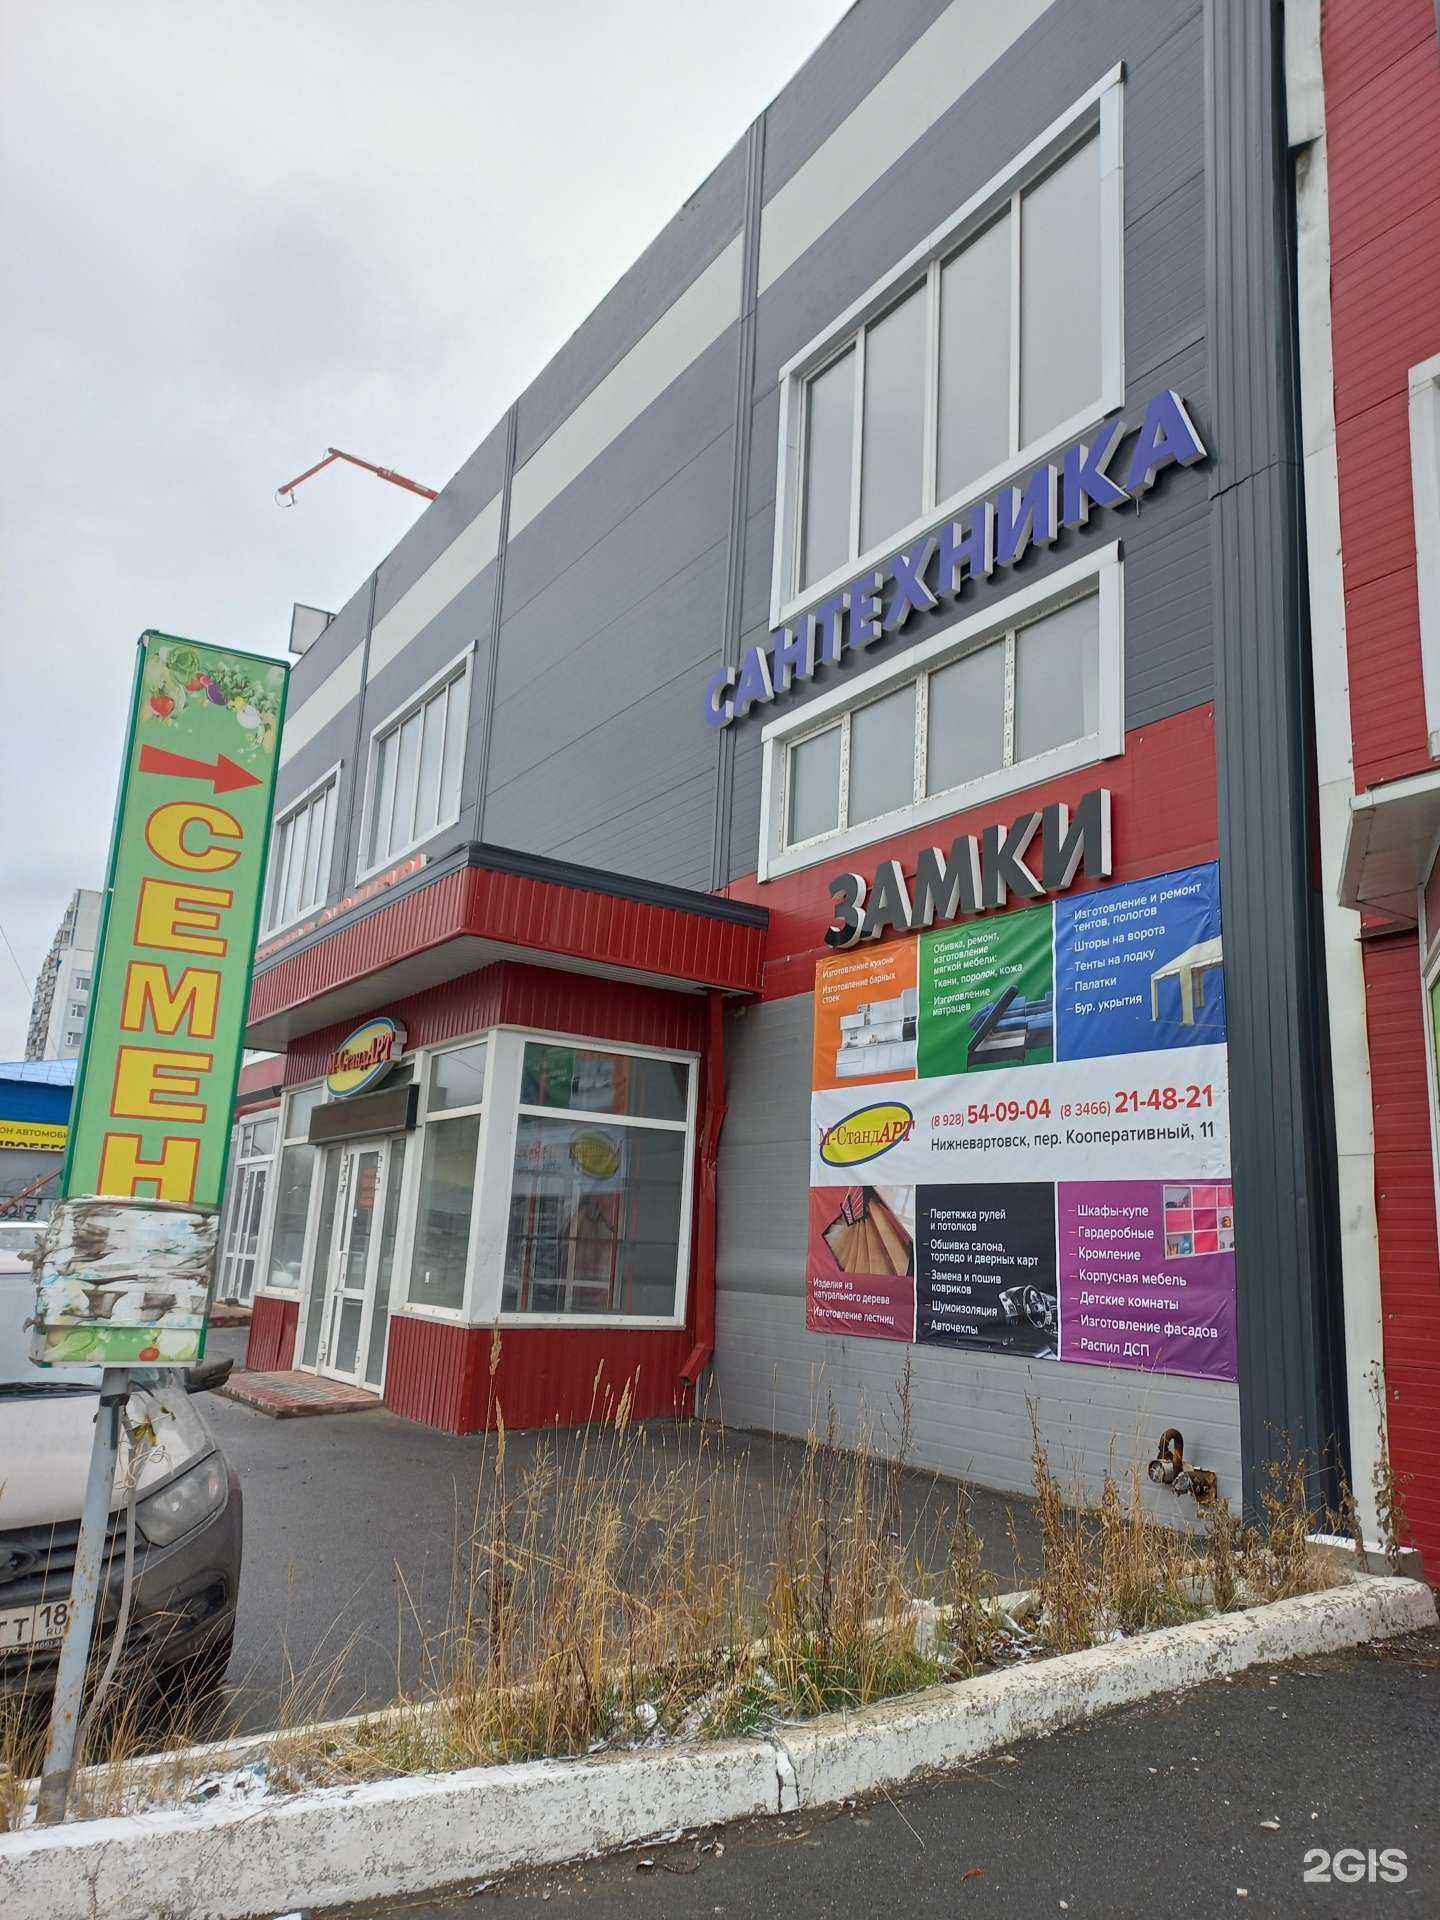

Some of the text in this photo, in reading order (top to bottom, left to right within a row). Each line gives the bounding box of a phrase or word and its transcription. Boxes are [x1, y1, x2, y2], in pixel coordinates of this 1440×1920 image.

[706, 389, 1207, 729] САНТЕХНИКА
[824, 788, 1112, 950] ЗАМКИ
[1073, 883, 1202, 920] Изготовление и ремонт
[1073, 906, 1157, 933] тентов, пологов
[933, 932, 1000, 954] Обивка, ремонт,
[1074, 926, 1166, 952] Шторы на ворота
[933, 945, 989, 965] изготовление
[1074, 948, 1155, 972] Тенты на лодку
[822, 961, 870, 979] Изготовление
[933, 954, 998, 975] мягкой мебели:
[822, 971, 896, 994] Изготовление барных
[933, 977, 960, 989] Ткани,
[961, 971, 998, 984] поролон,
[1074, 976, 1117, 992] Палатки
[822, 994, 841, 1005] стоек
[933, 988, 991, 1006] Изготовление
[1074, 994, 1143, 1015] Бур. укрытия
[932, 1002, 971, 1017] матрацев
[931, 1084, 1213, 1130] (8 928) 54-09-04 (8 3466) 21-48-21
[931, 1121, 1214, 1152] Нижневартовск, пер. Кооперативный, 11
[930, 1208, 1006, 1222] Перетяжка рулей
[1077, 1204, 1149, 1219] Шкафы-купе
[930, 1222, 977, 1231] и потолков
[1078, 1225, 1155, 1241] Гардеробные
[930, 1238, 1006, 1253] Обшивка салона,
[1078, 1246, 1141, 1261] Кромление
[930, 1252, 1039, 1268] торпедо и дверных карт
[813, 1277, 853, 1290] Изделия из
[931, 1269, 1002, 1284] Замена и пошив
[1079, 1268, 1187, 1286] Корпусная мебель
[813, 1290, 890, 1306] натурального дерева
[931, 1283, 972, 1295] ковриков
[932, 1300, 998, 1317] Шумоизоляция
[1080, 1291, 1179, 1310] Детские комнаты
[813, 1306, 895, 1326] Изготовление лестниц
[930, 1319, 978, 1334] Авточехлы
[1080, 1314, 1218, 1339] Изготовление фасадов
[1080, 1338, 1149, 1357] Распил ДСП
[40, 1603, 68, 1628] 18
